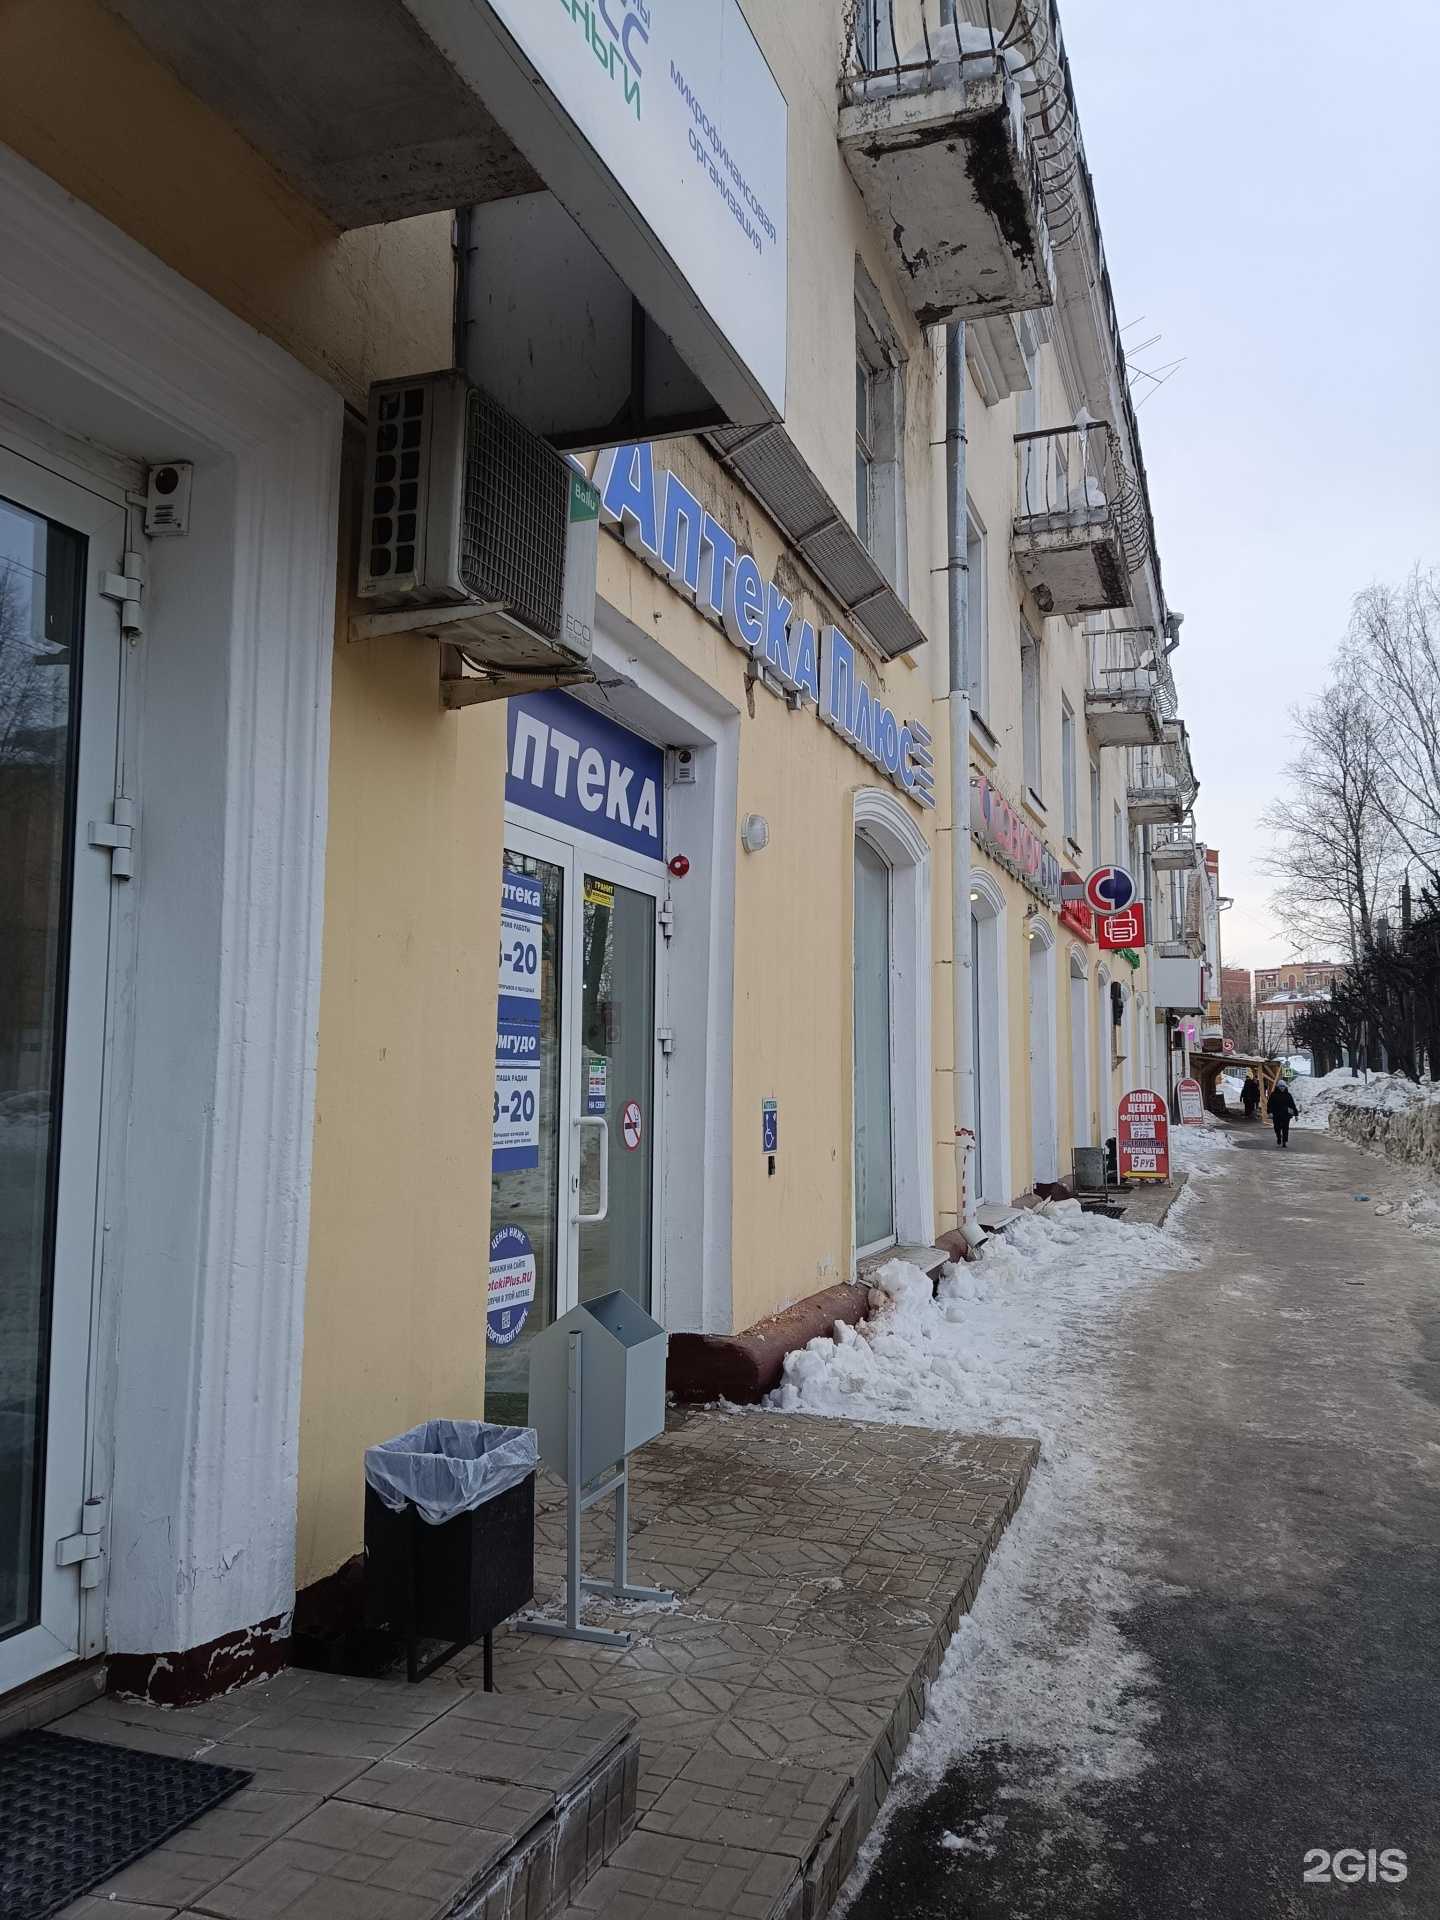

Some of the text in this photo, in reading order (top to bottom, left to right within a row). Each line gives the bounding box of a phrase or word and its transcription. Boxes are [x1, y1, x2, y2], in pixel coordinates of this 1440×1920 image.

[669, 59, 777, 244] микрофинансовая
[687, 127, 762, 255] организация
[566, 613, 591, 642] ECO
[501, 883, 541, 907] птека
[497, 1032, 536, 1054] мгудо
[1128, 1103, 1156, 1113] ЦЕНТР
[1130, 1093, 1154, 1102] КОПИ
[1133, 1156, 1154, 1168] 5 РУБ
[491, 1227, 509, 1249] ЦЕНЫ
